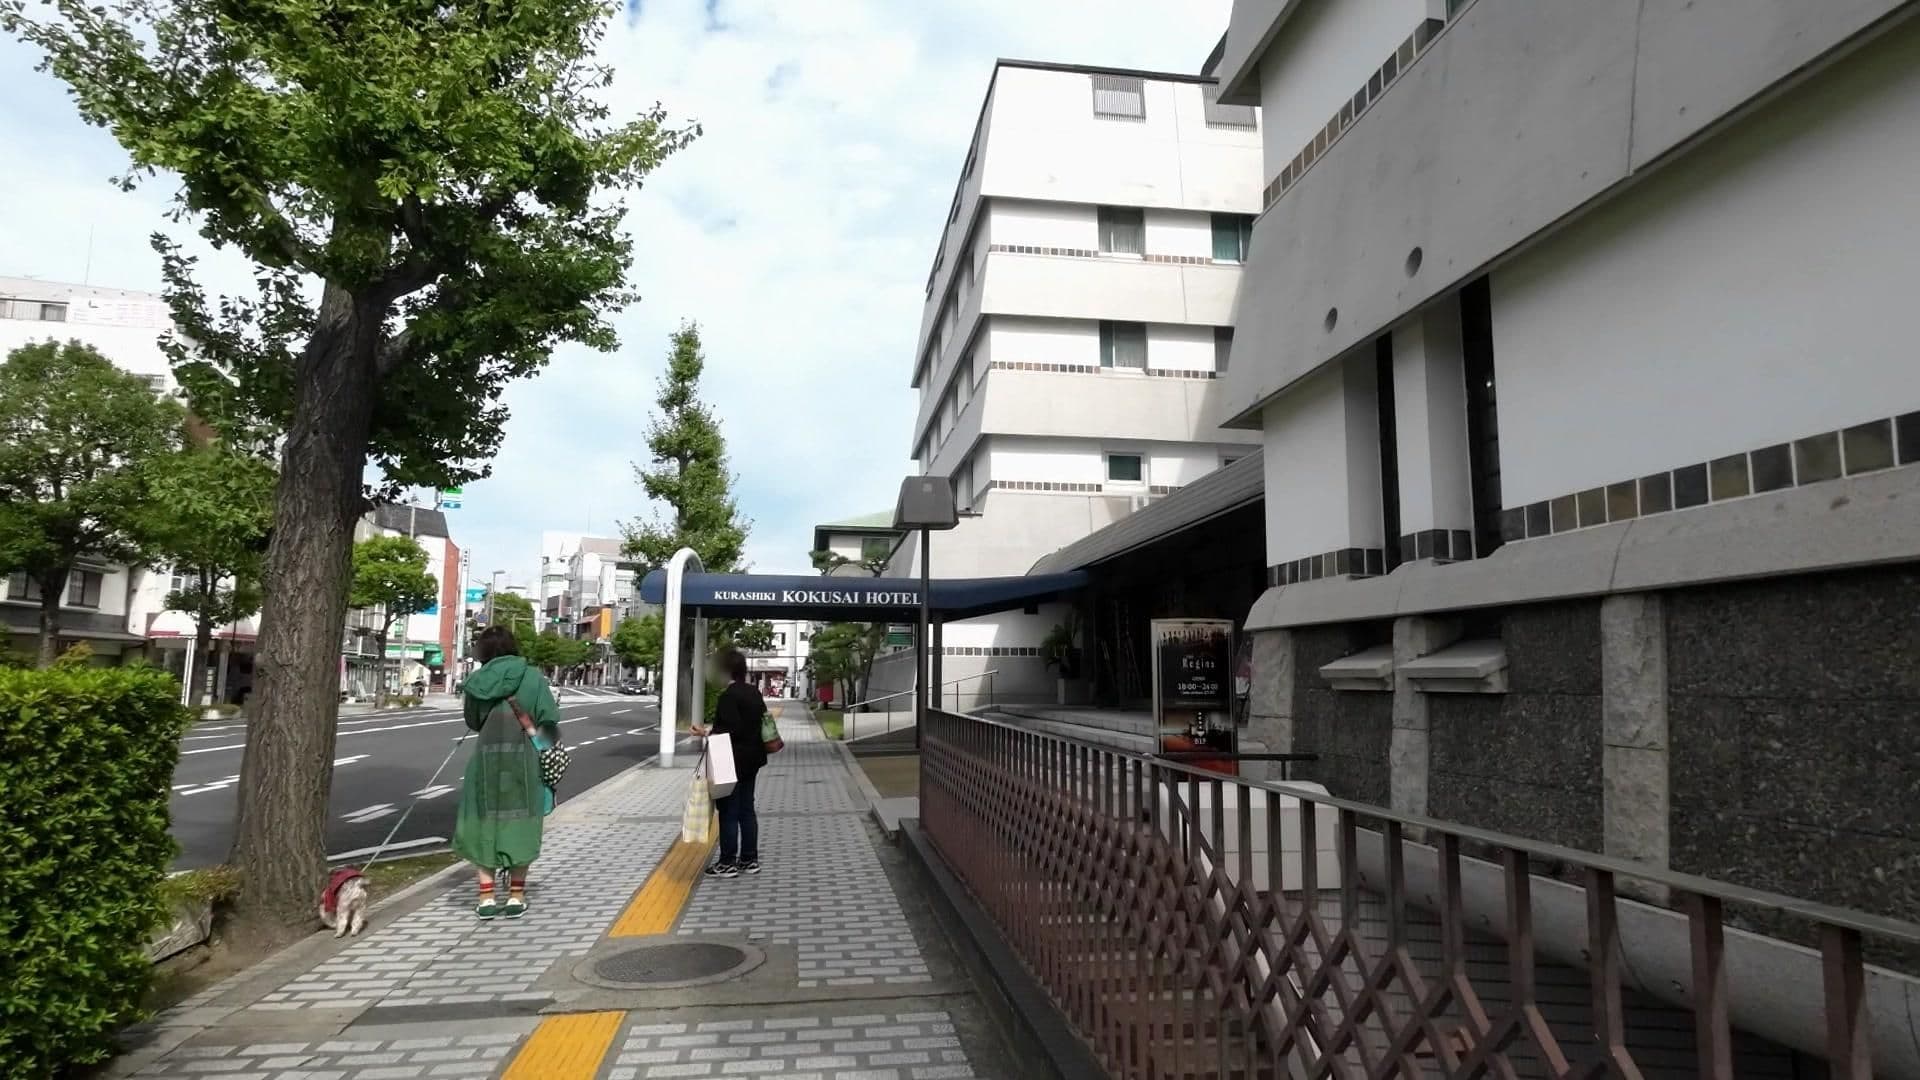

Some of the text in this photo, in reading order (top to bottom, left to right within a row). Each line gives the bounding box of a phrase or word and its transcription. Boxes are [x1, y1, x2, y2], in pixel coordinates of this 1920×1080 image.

[714, 590, 921, 605] KURASHIKI KOKUSAI HOTEL
